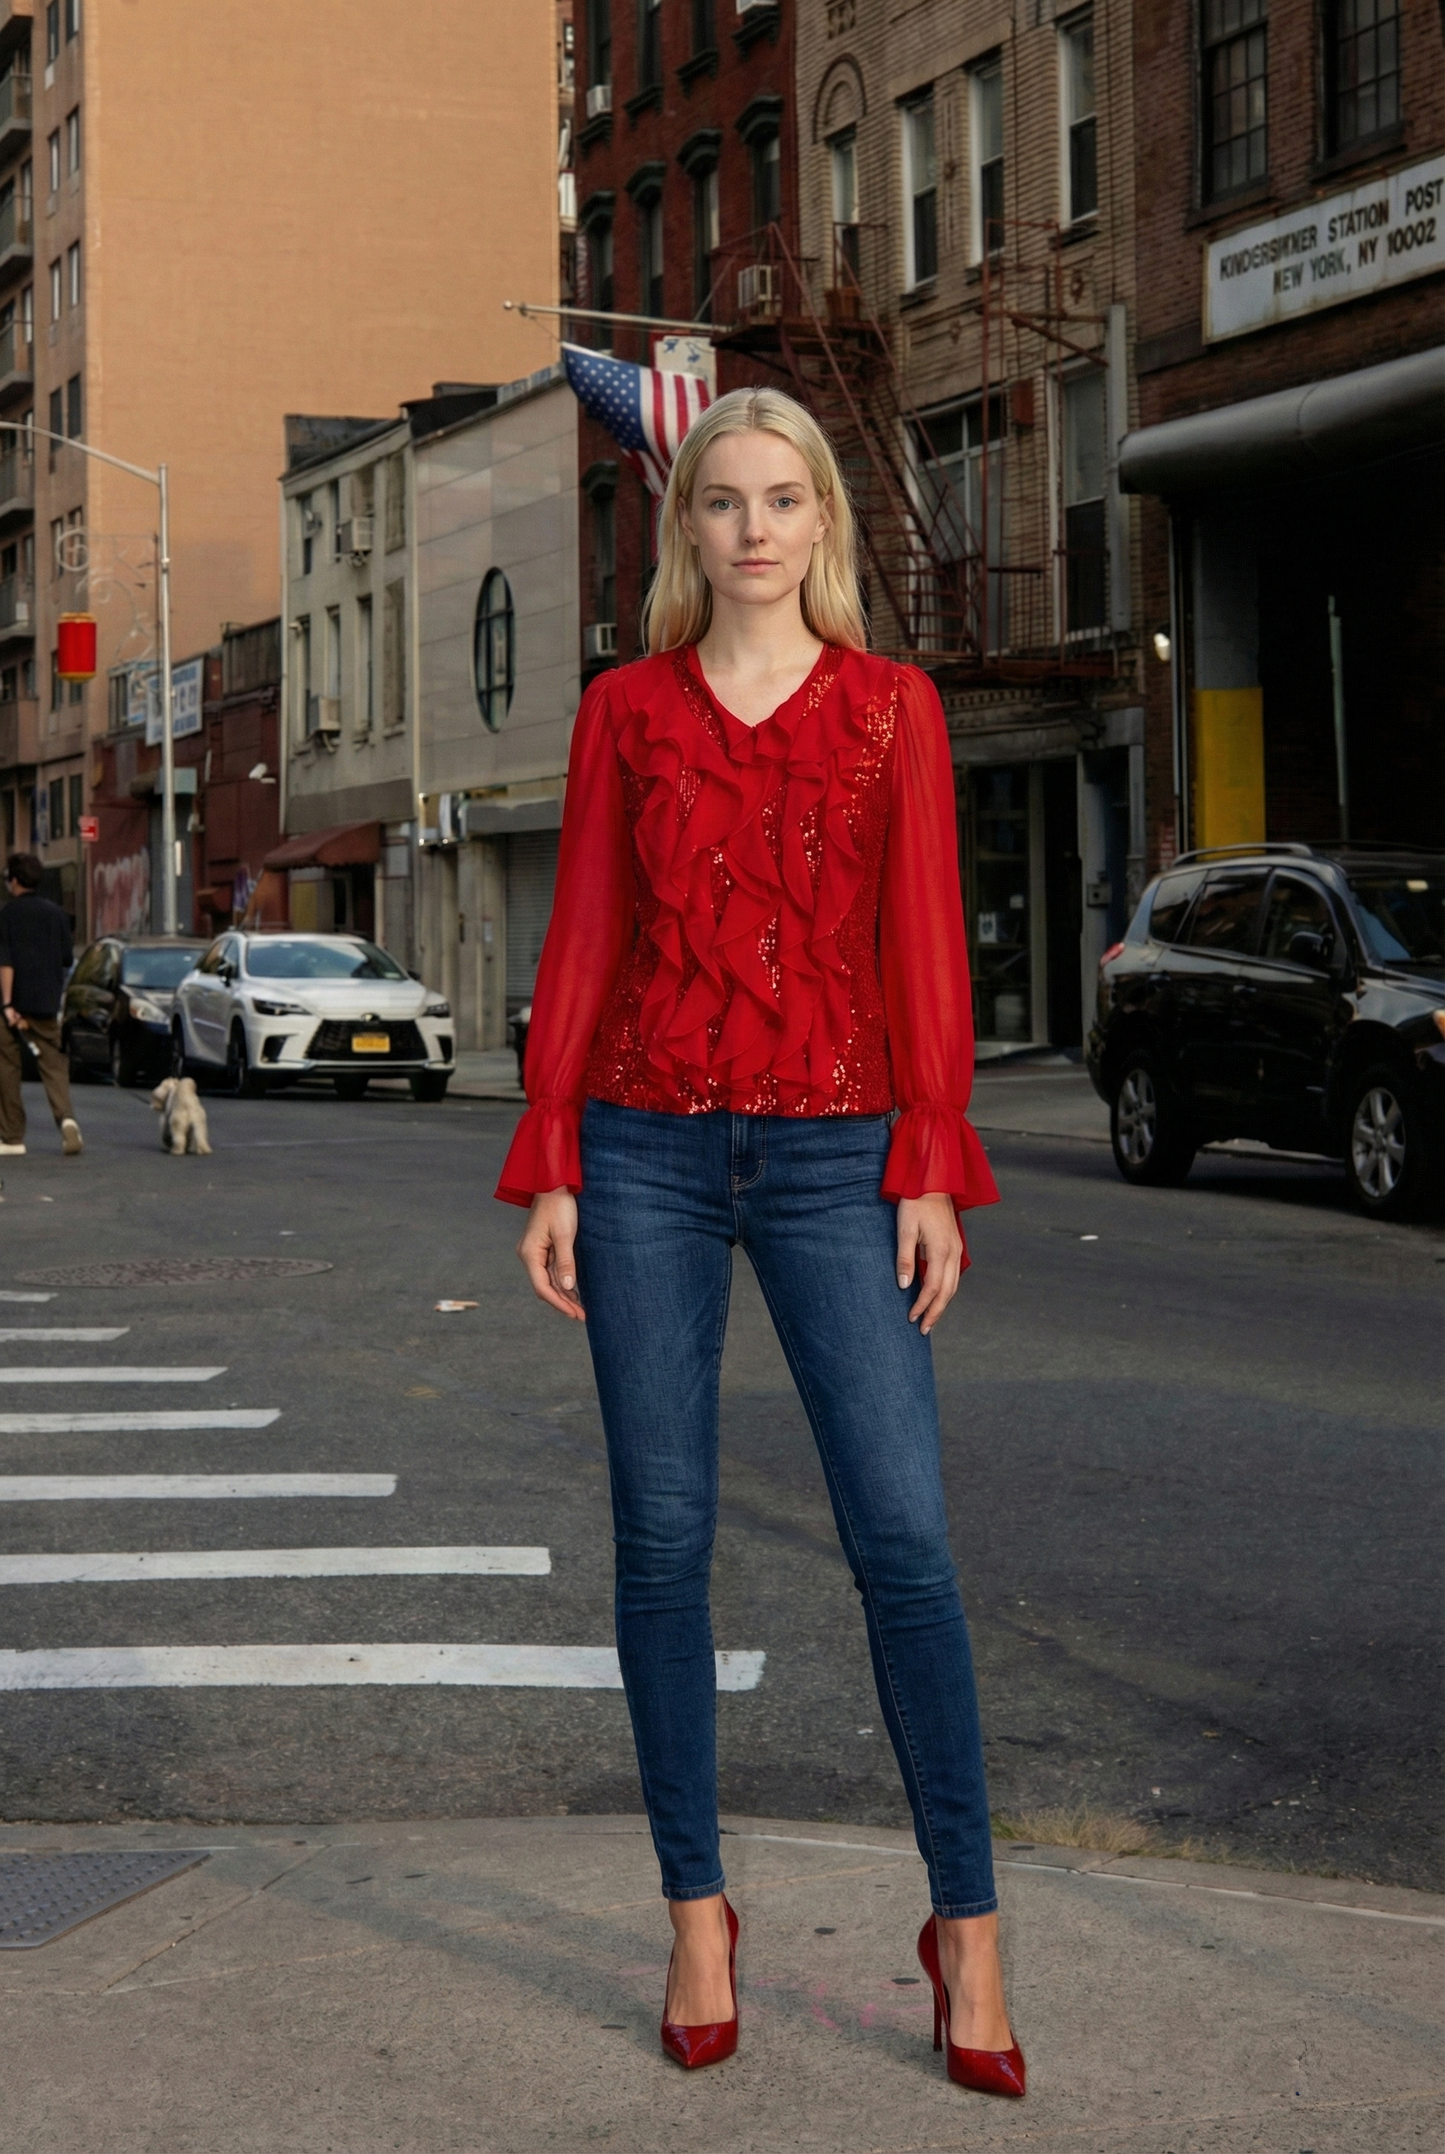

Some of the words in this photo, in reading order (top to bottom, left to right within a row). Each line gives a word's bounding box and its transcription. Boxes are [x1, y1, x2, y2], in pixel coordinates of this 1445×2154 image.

[1328, 199, 1390, 243] STATION
[1405, 178, 1444, 216] POST
[1274, 263, 1304, 295] NEW
[1310, 248, 1352, 281] YORK,
[1358, 236, 1379, 268] NY
[1387, 217, 1436, 257] 10002
